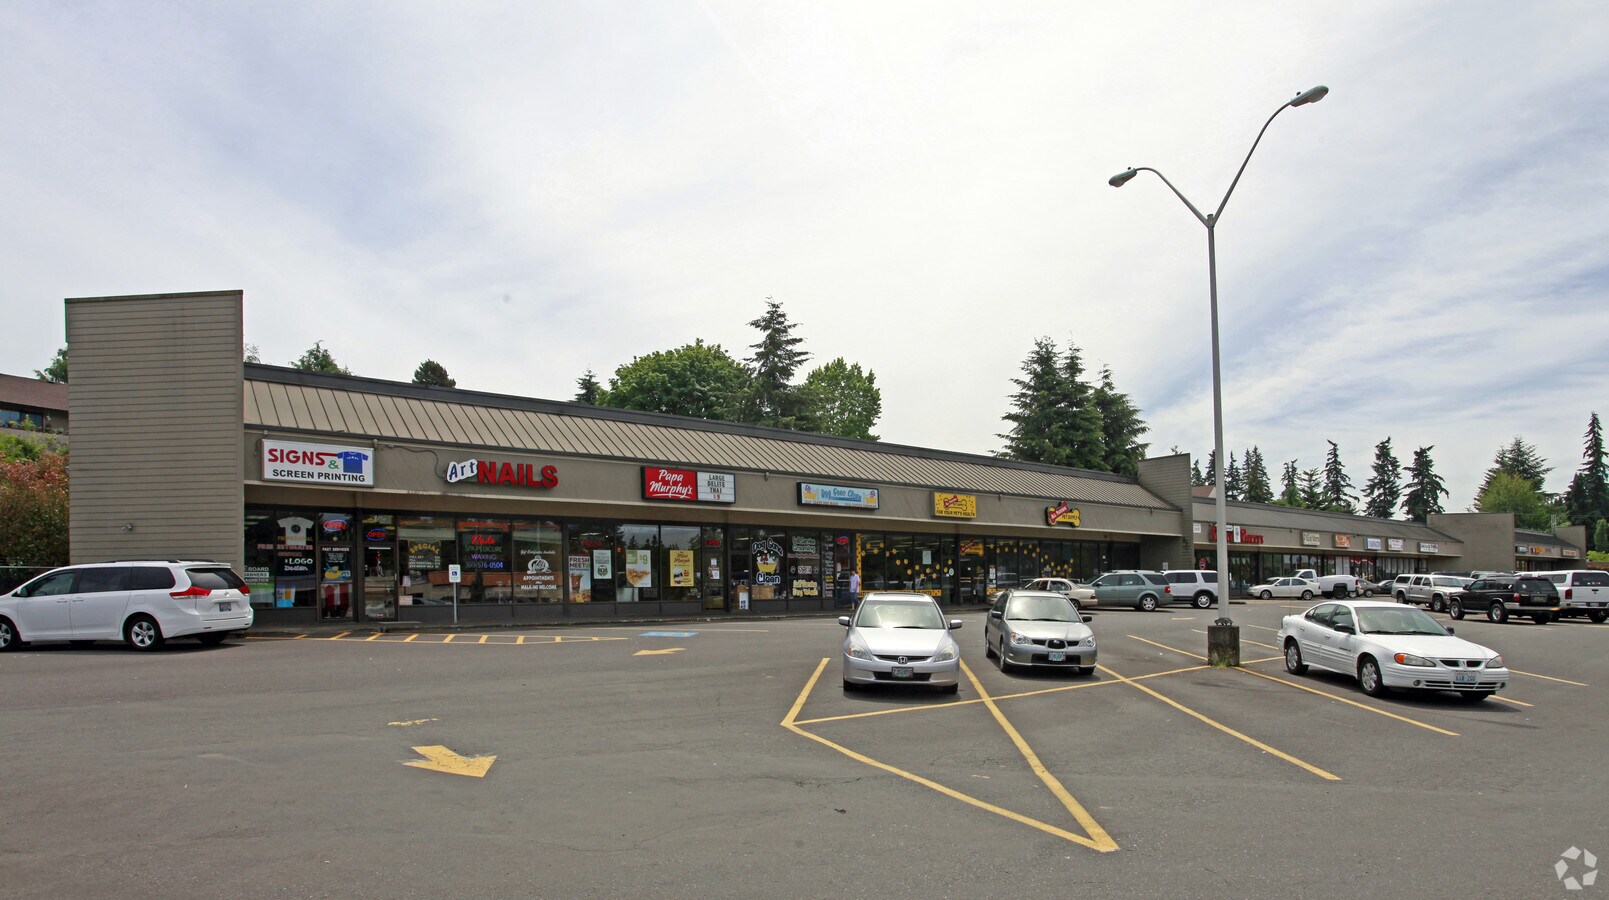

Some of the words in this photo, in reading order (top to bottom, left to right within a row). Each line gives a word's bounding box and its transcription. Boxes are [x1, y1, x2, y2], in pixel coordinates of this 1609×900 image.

[268, 448, 327, 466] SIGNS
[328, 460, 339, 469] &
[272, 469, 314, 479] SCREEN
[318, 472, 365, 482] PRINTING
[449, 461, 475, 480] Art
[477, 460, 558, 488] NAILS
[659, 469, 684, 485] Papa
[650, 481, 693, 498] Murphy's
[471, 534, 496, 545] Nails
[410, 543, 440, 554] SPECIAL
[752, 541, 766, 554] Dog
[757, 571, 781, 584] Clean
